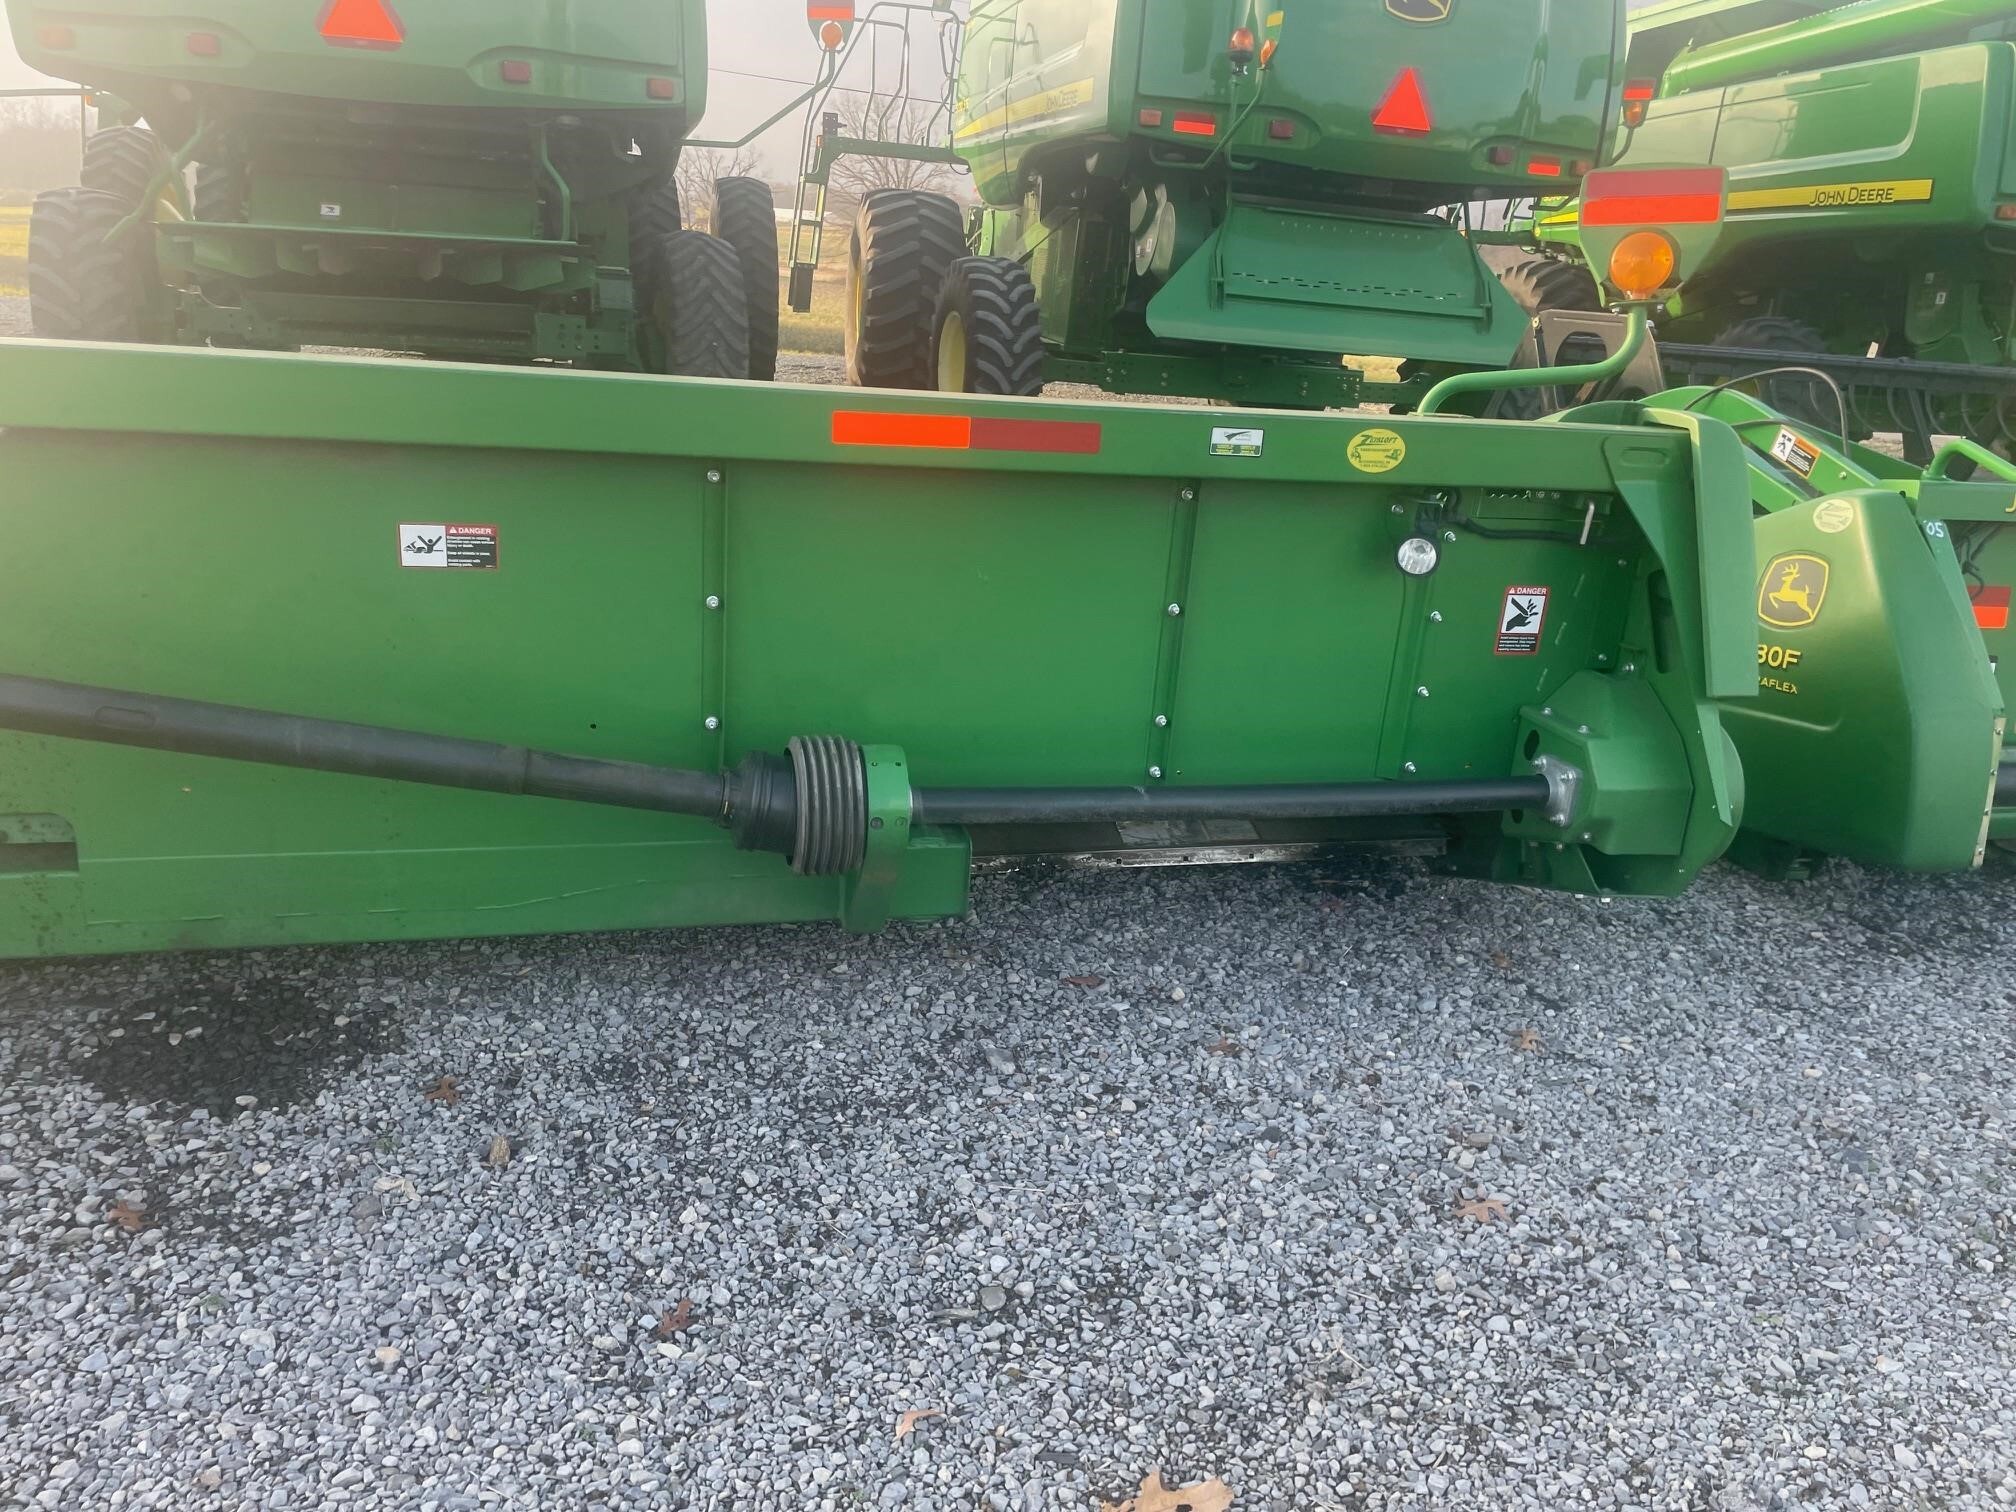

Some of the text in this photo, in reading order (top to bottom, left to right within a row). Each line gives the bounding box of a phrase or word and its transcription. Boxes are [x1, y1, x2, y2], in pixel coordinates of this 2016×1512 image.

[1809, 186, 1895, 204] JOHN DEERE
[458, 527, 492, 535] DANGER
[1516, 587, 1547, 595] DANGER
[1758, 676, 1798, 695] AFLEX
